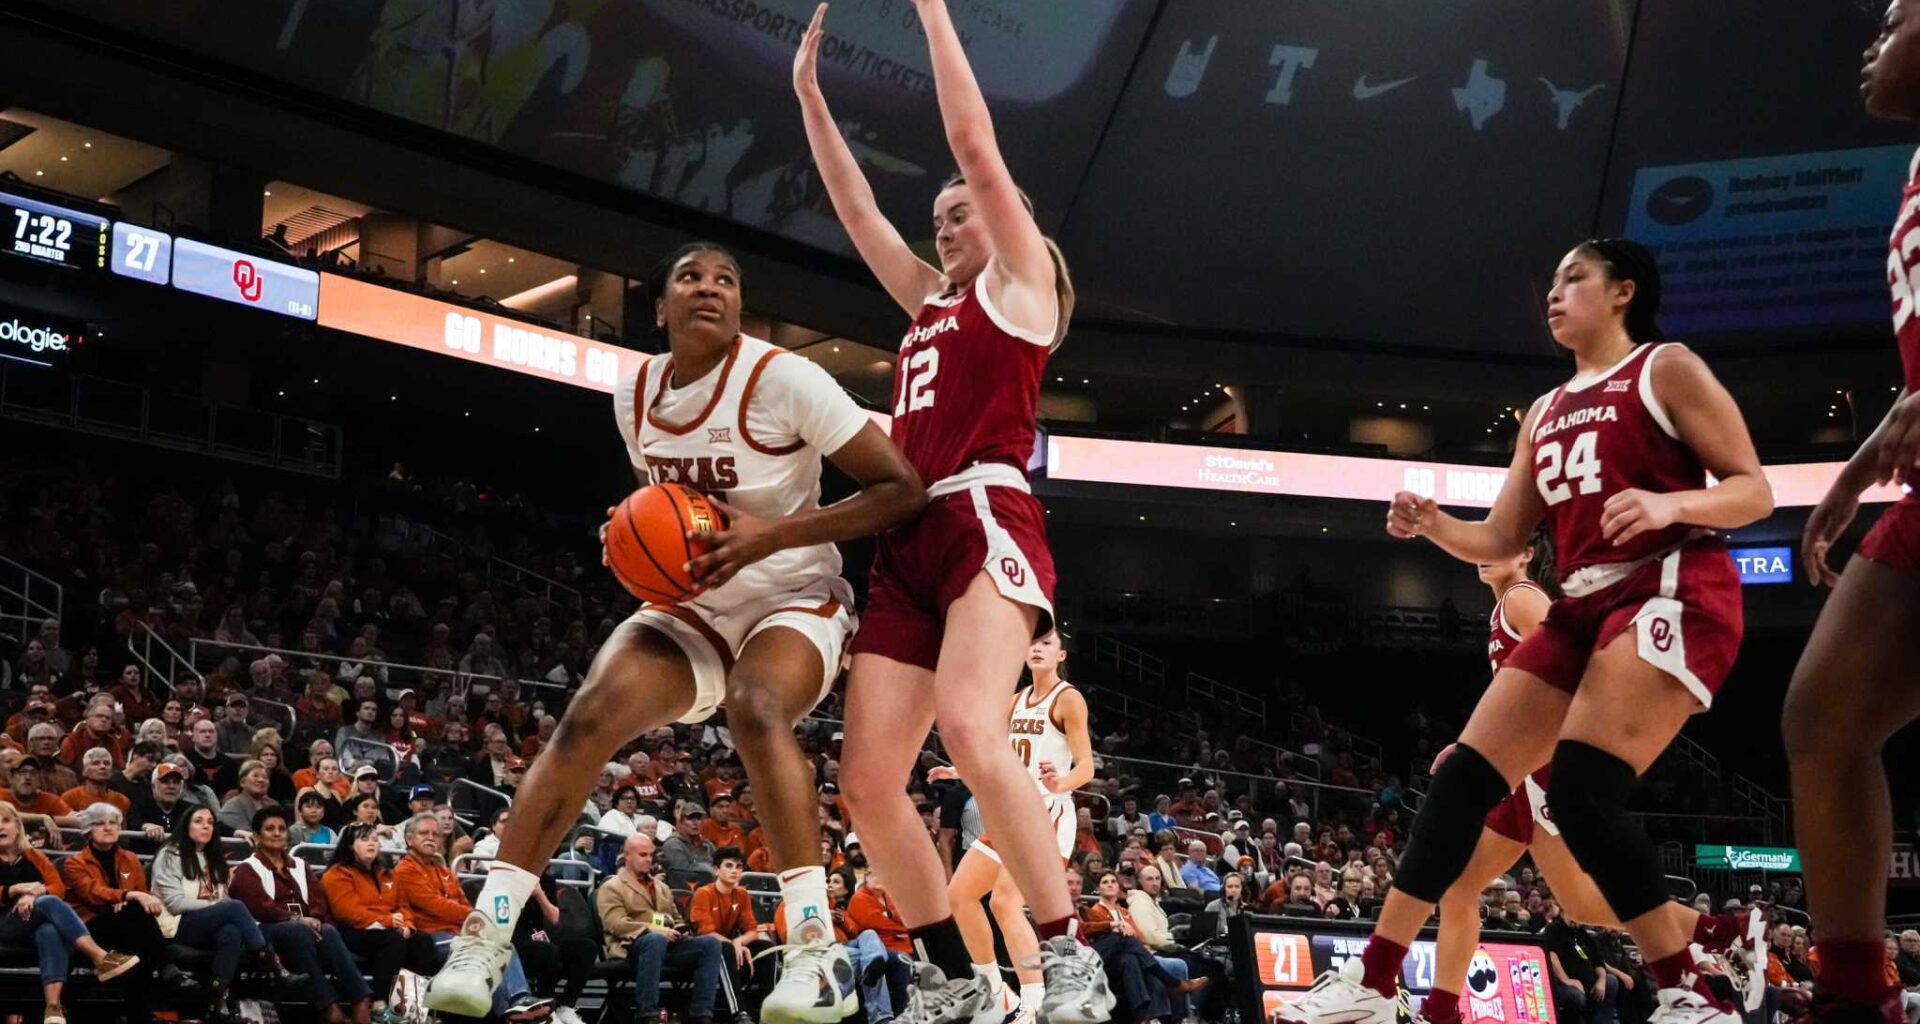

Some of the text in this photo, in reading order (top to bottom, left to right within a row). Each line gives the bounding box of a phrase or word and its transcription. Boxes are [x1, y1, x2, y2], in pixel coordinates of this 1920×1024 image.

[15, 208, 72, 250] 7:22
[14, 240, 65, 262] 2ND QUARTER
[125, 232, 159, 272] 27
[233, 259, 263, 302] OU
[445, 312, 619, 386] GO HORNS GO
[894, 347, 939, 418] 12
[1535, 406, 1618, 443] OKLAHOMA
[644, 455, 740, 490] TEXAS
[1404, 467, 1506, 501] GO HORN
[1536, 431, 1602, 507] 24
[1001, 557, 1025, 587] OU
[1650, 617, 1674, 652] OU
[1009, 718, 1045, 735] EXAS
[1741, 850, 1792, 863] Germania
[1269, 936, 1297, 983] 27
[1412, 942, 1436, 987] 27
